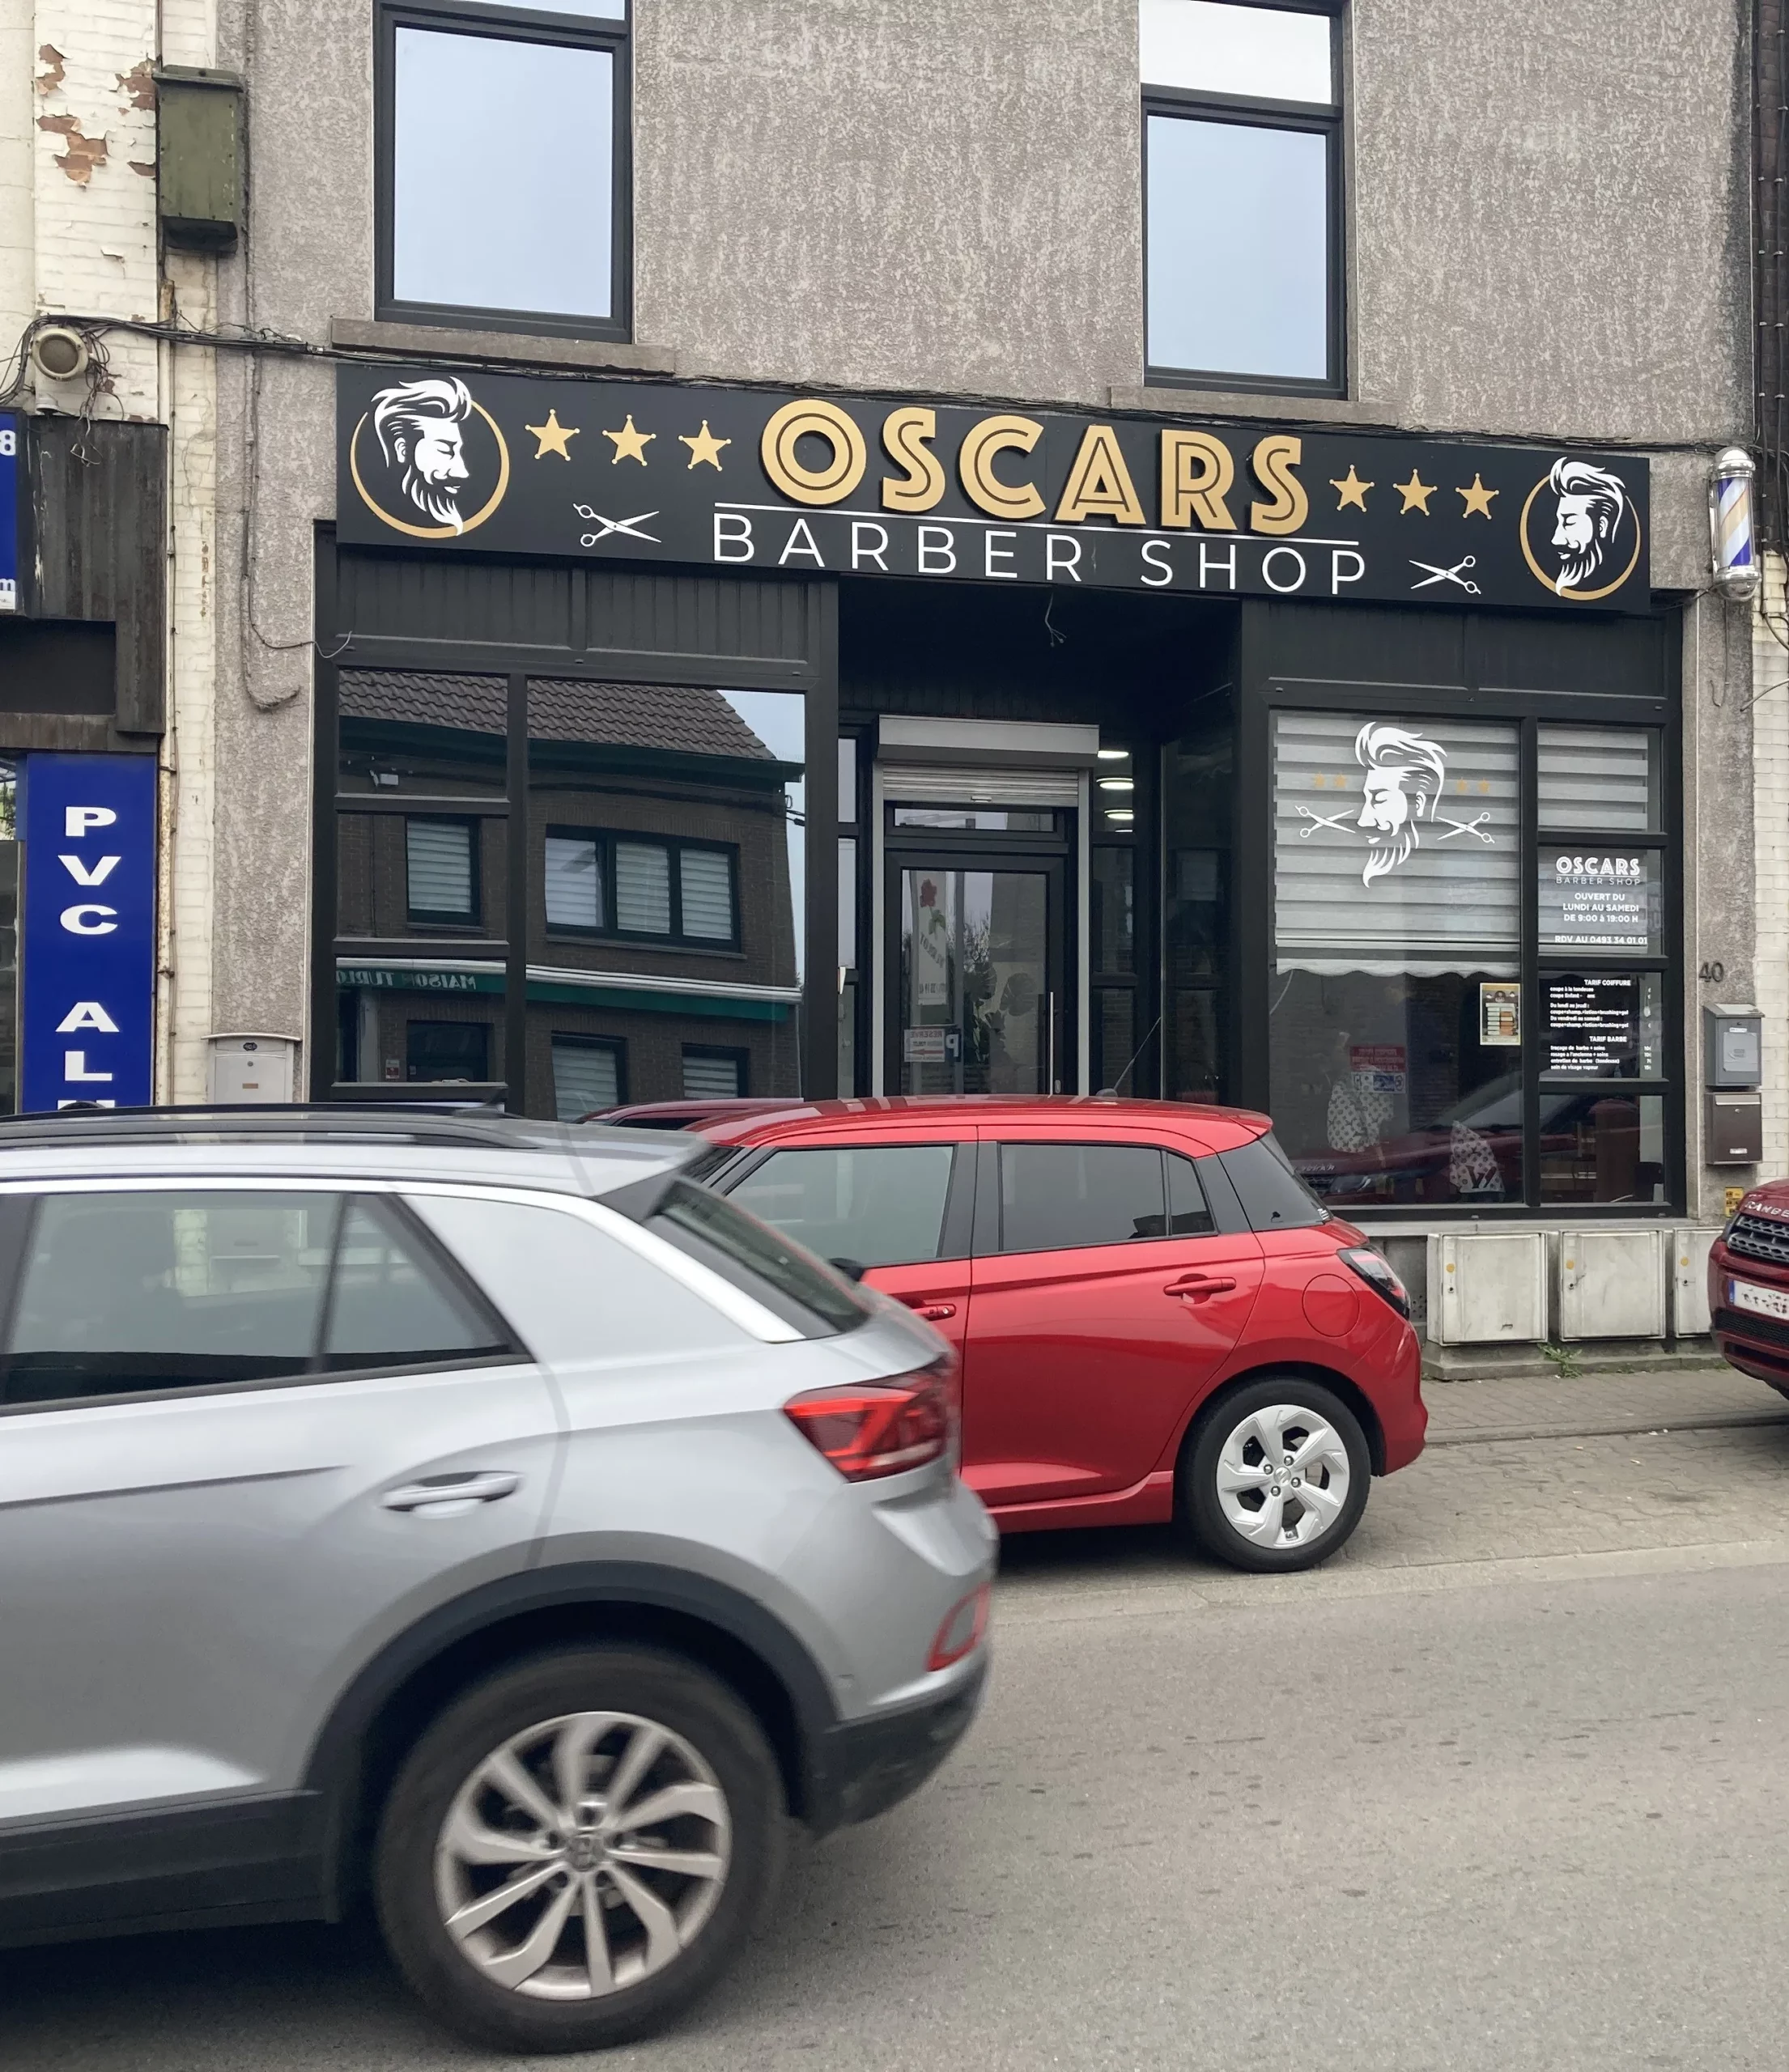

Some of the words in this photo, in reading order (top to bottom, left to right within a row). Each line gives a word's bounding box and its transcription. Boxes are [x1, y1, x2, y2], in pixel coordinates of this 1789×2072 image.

[760, 398, 1309, 536] OSCARS
[713, 513, 1082, 582] BARBER
[1140, 540, 1366, 595] SHOP
[57, 806, 121, 935] PVC
[1556, 856, 1640, 875] OSCARS
[1556, 877, 1603, 885] BARBER
[1574, 893, 1611, 901] OUVERT
[1605, 904, 1639, 912] SAMEDI
[1607, 915, 1630, 923] 19:00
[1575, 936, 1588, 944] AU
[1698, 962, 1724, 983] 40
[56, 1002, 120, 1110] AL
